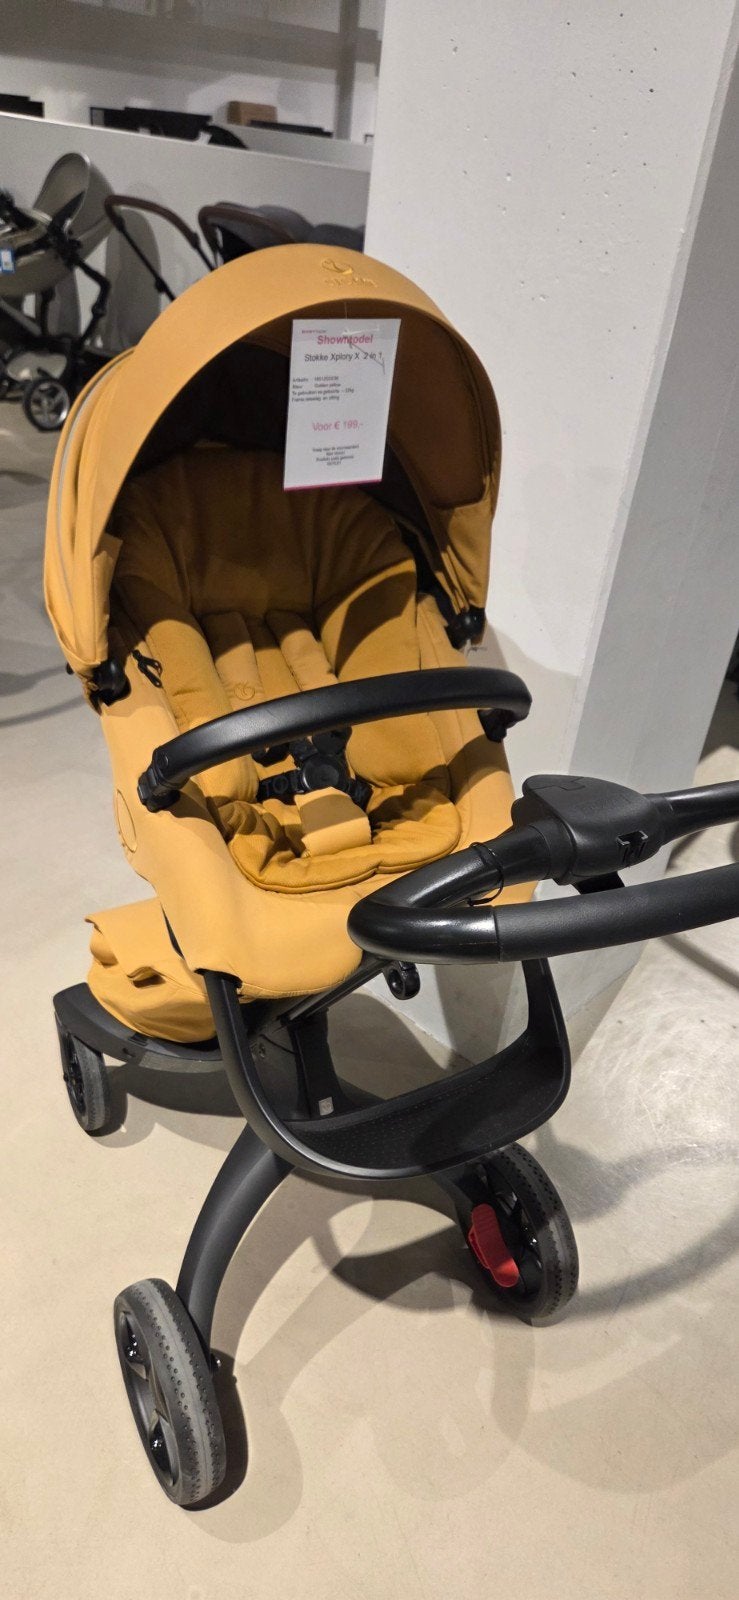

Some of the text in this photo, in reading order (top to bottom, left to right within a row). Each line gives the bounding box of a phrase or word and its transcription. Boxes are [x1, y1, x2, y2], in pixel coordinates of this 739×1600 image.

[304, 353, 329, 362] Stokke
[330, 352, 353, 362] Xplory
[354, 352, 360, 360] X
[363, 352, 369, 360] 2
[312, 422, 333, 431] Voor
[334, 420, 341, 430] €
